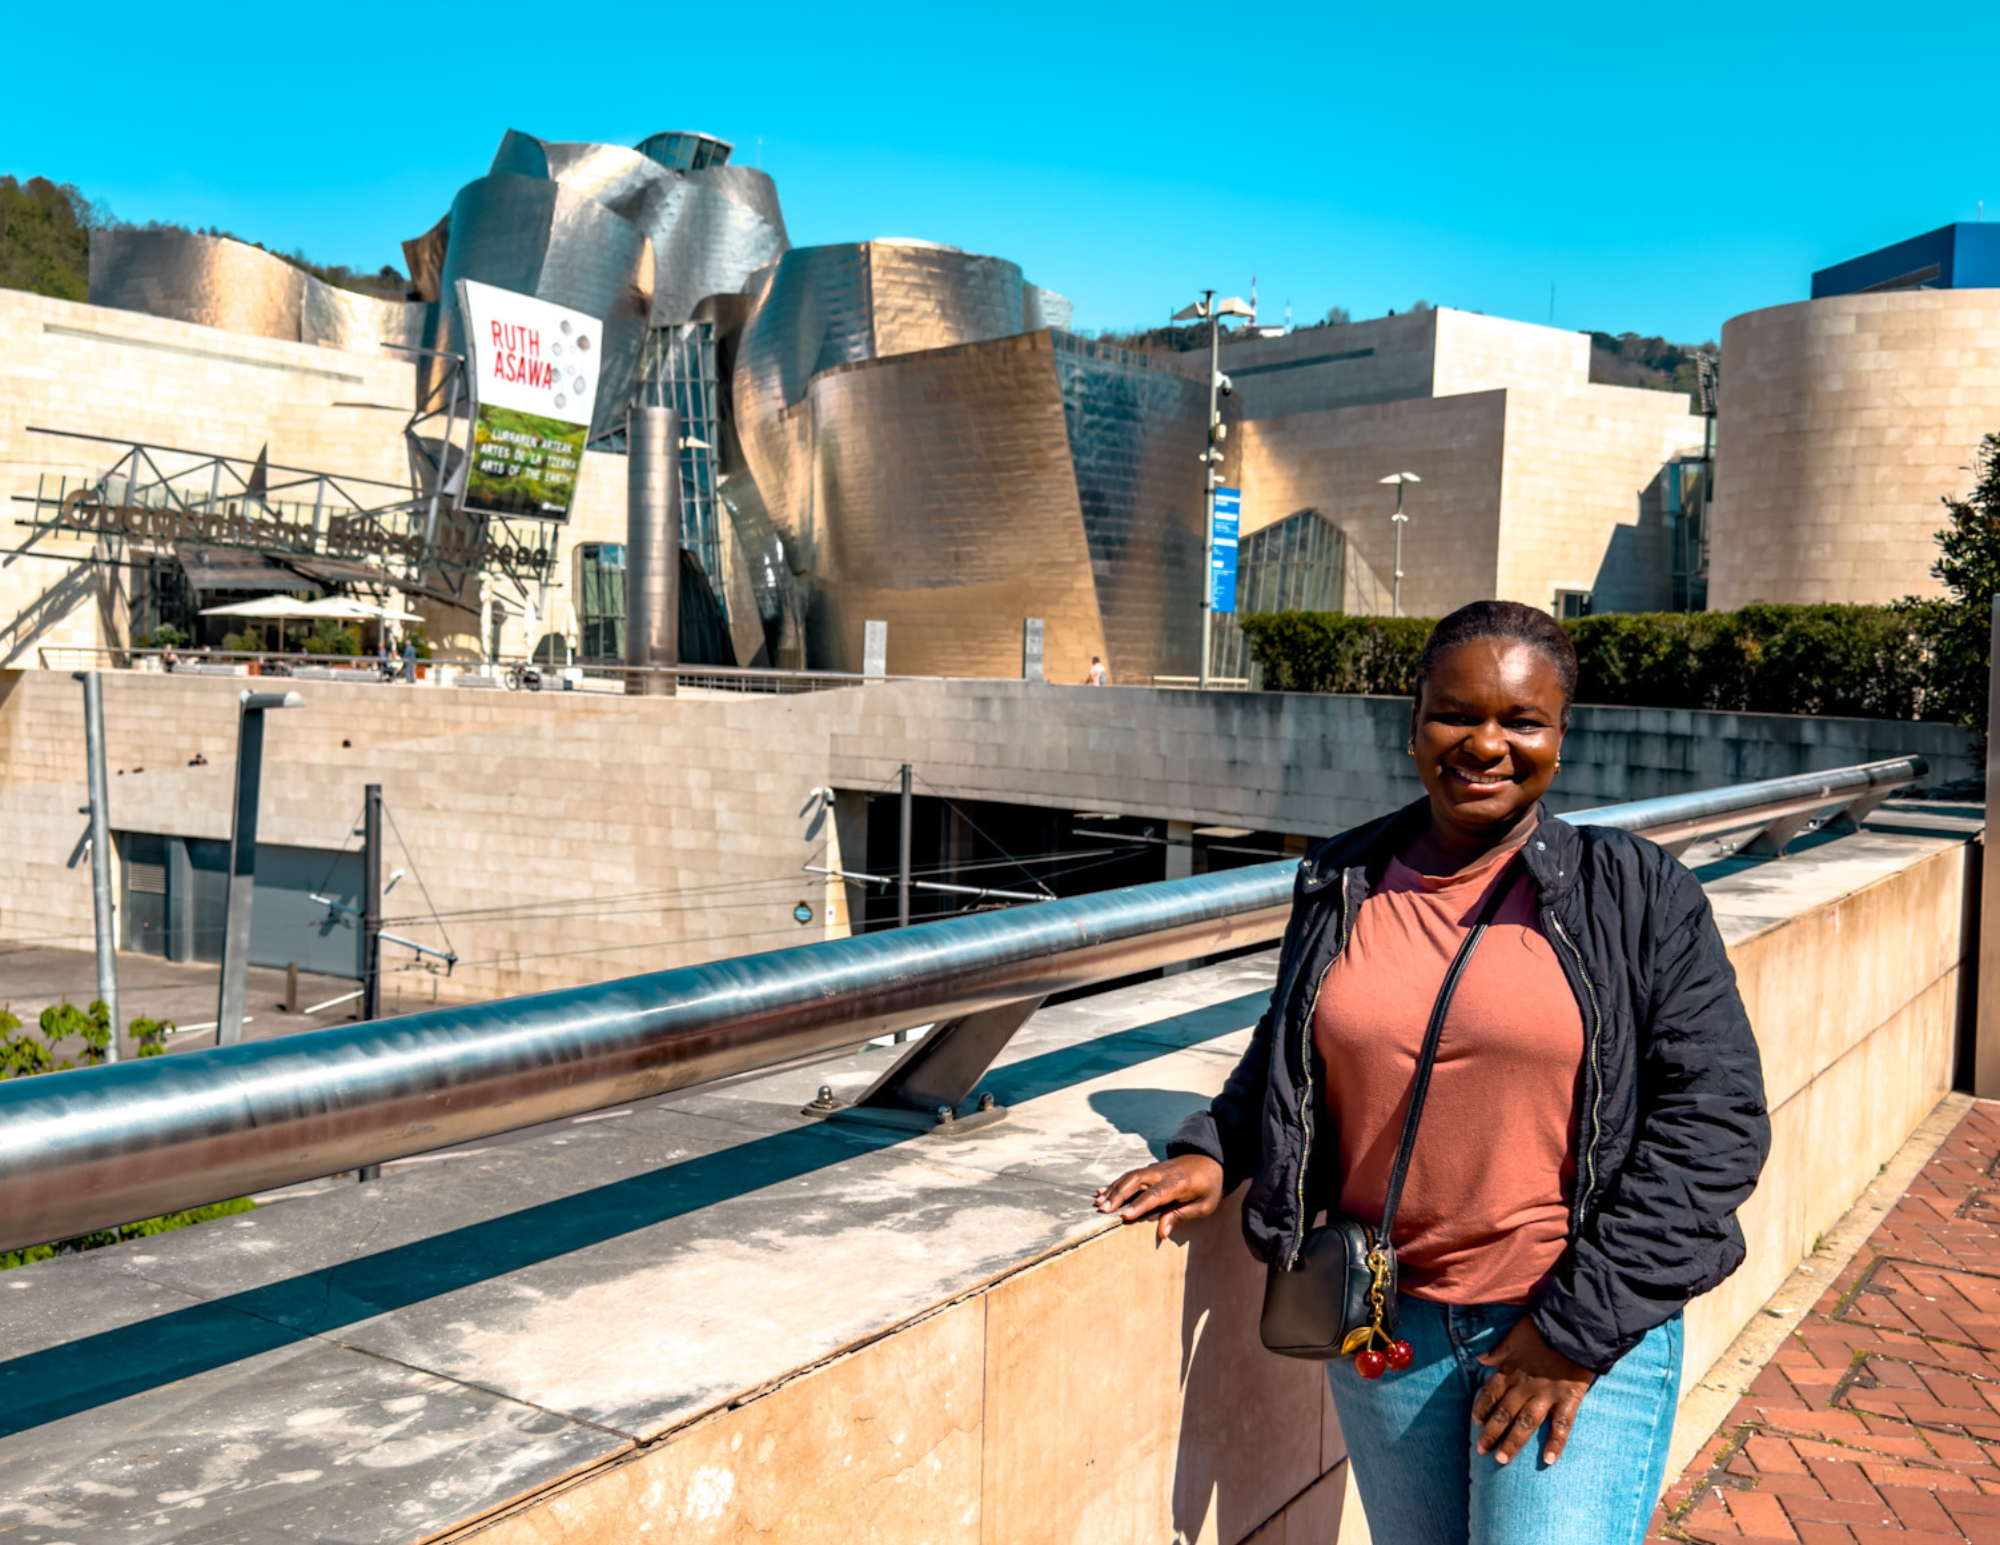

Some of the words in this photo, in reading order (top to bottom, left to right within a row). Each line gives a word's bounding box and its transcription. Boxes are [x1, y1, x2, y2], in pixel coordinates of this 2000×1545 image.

[491, 319, 540, 357] RUTH
[494, 350, 552, 391] ASAWA
[480, 442, 510, 459] ARTES
[514, 449, 526, 462] DE
[530, 453, 542, 465] LA
[541, 439, 573, 455] ARTEAK
[480, 458, 505, 475] ARTS
[507, 463, 521, 476] OF
[525, 467, 542, 481] THE
[545, 470, 571, 484] EARTH
[64, 489, 314, 550] Guggenheim
[328, 516, 425, 559] Bilbao
